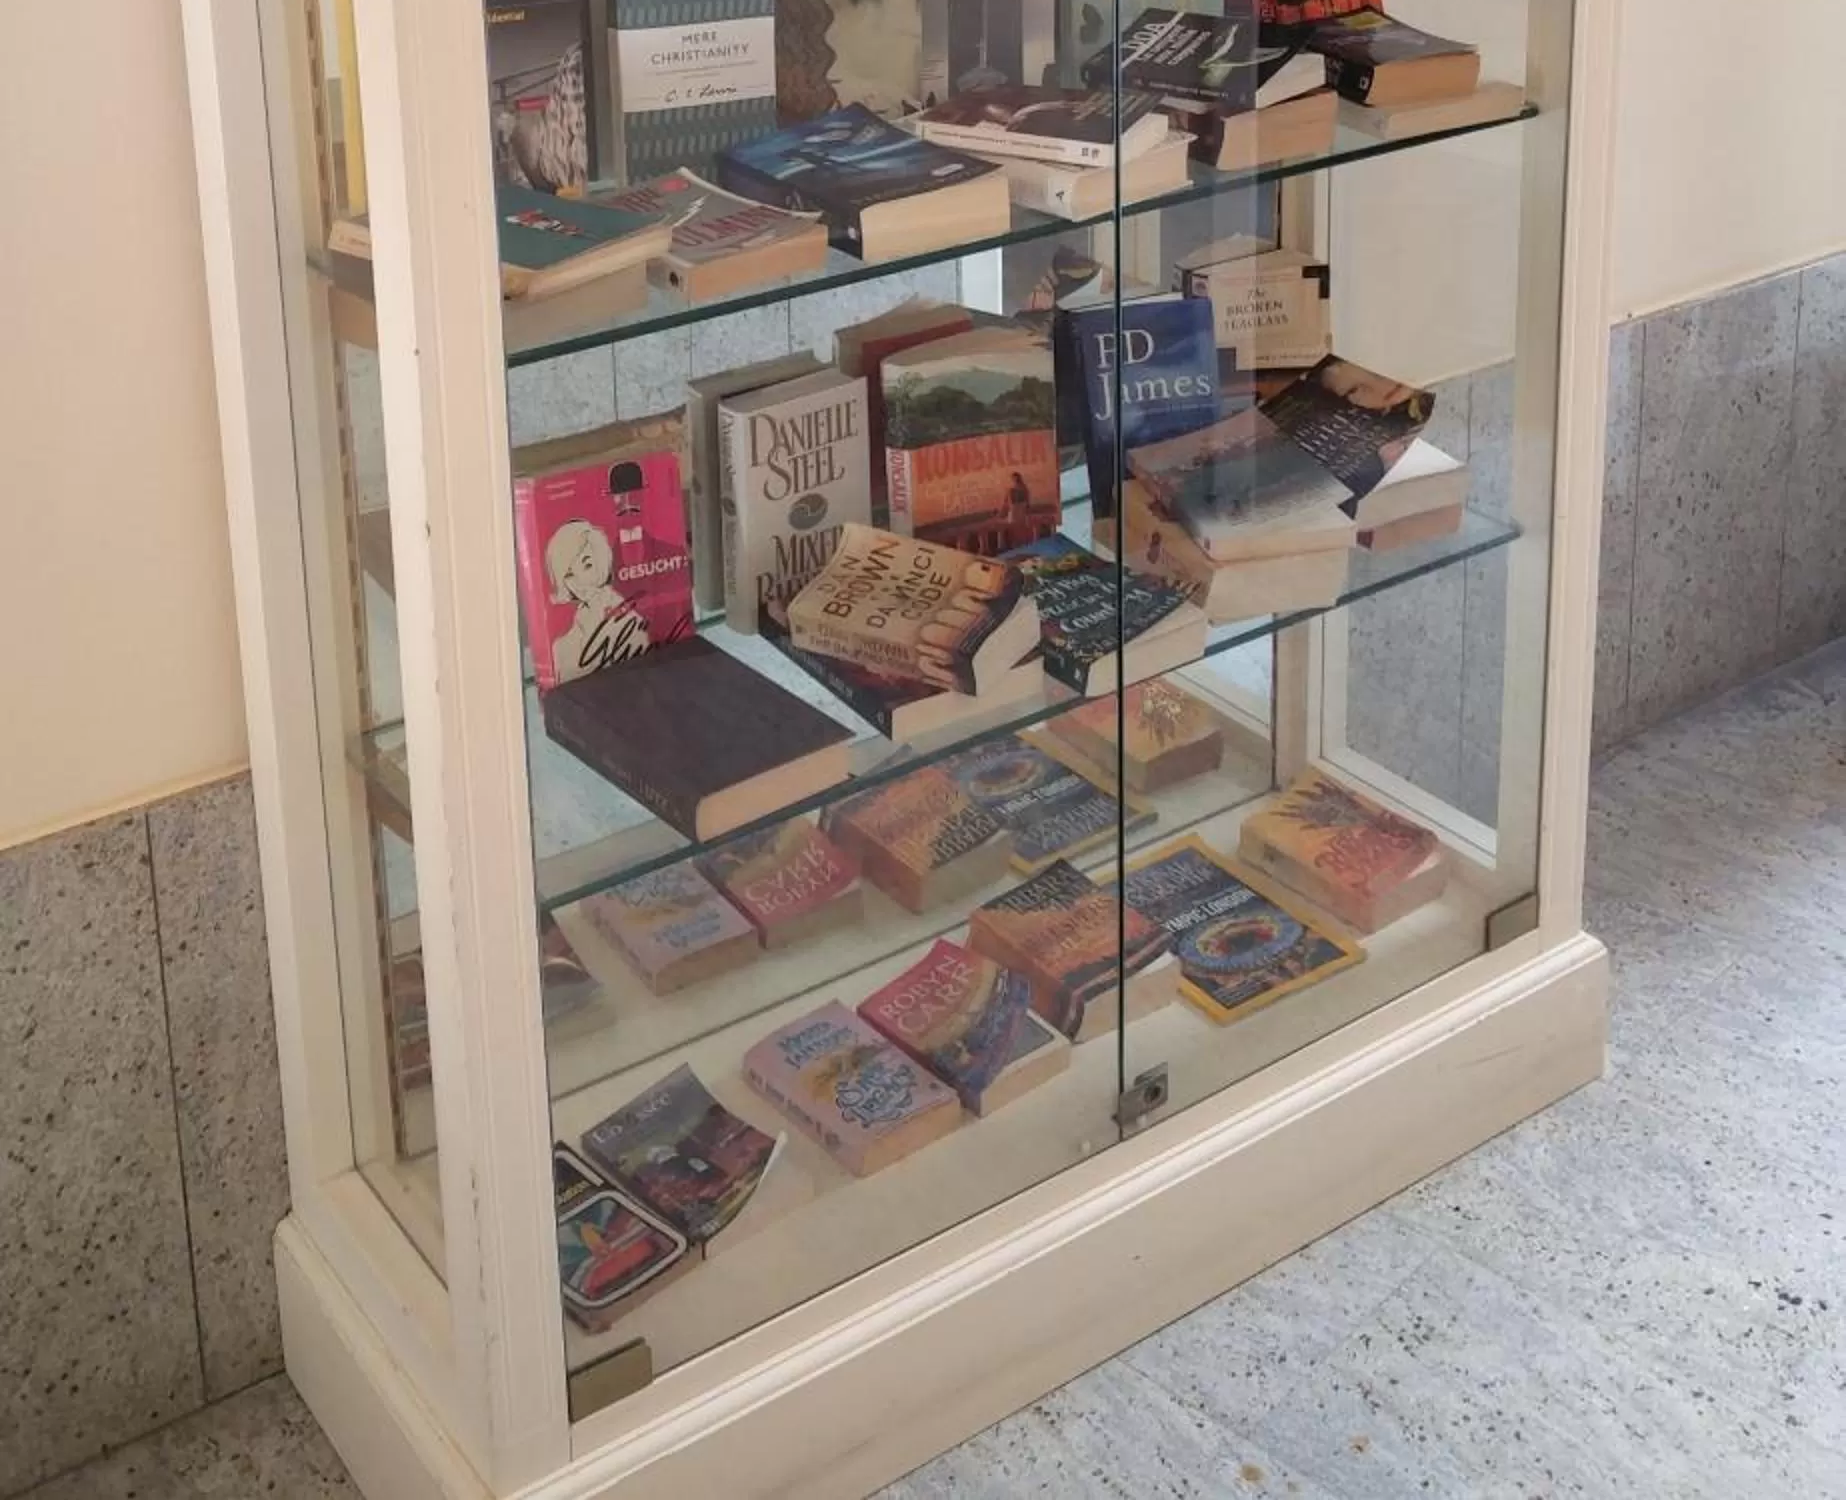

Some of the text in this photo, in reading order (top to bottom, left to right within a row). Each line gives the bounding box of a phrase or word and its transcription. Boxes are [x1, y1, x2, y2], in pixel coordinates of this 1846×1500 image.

[650, 43, 750, 65] CHRISTIANITY
[681, 30, 718, 45] MERE
[748, 398, 859, 469] DANIELLE
[763, 445, 846, 501] STEEL
[817, 555, 862, 595] DAN
[823, 535, 902, 619] BROWN
[901, 571, 953, 621] CODE
[866, 604, 897, 629] DA
[879, 953, 959, 1021] ROBYN
[897, 962, 974, 1034] CARR
